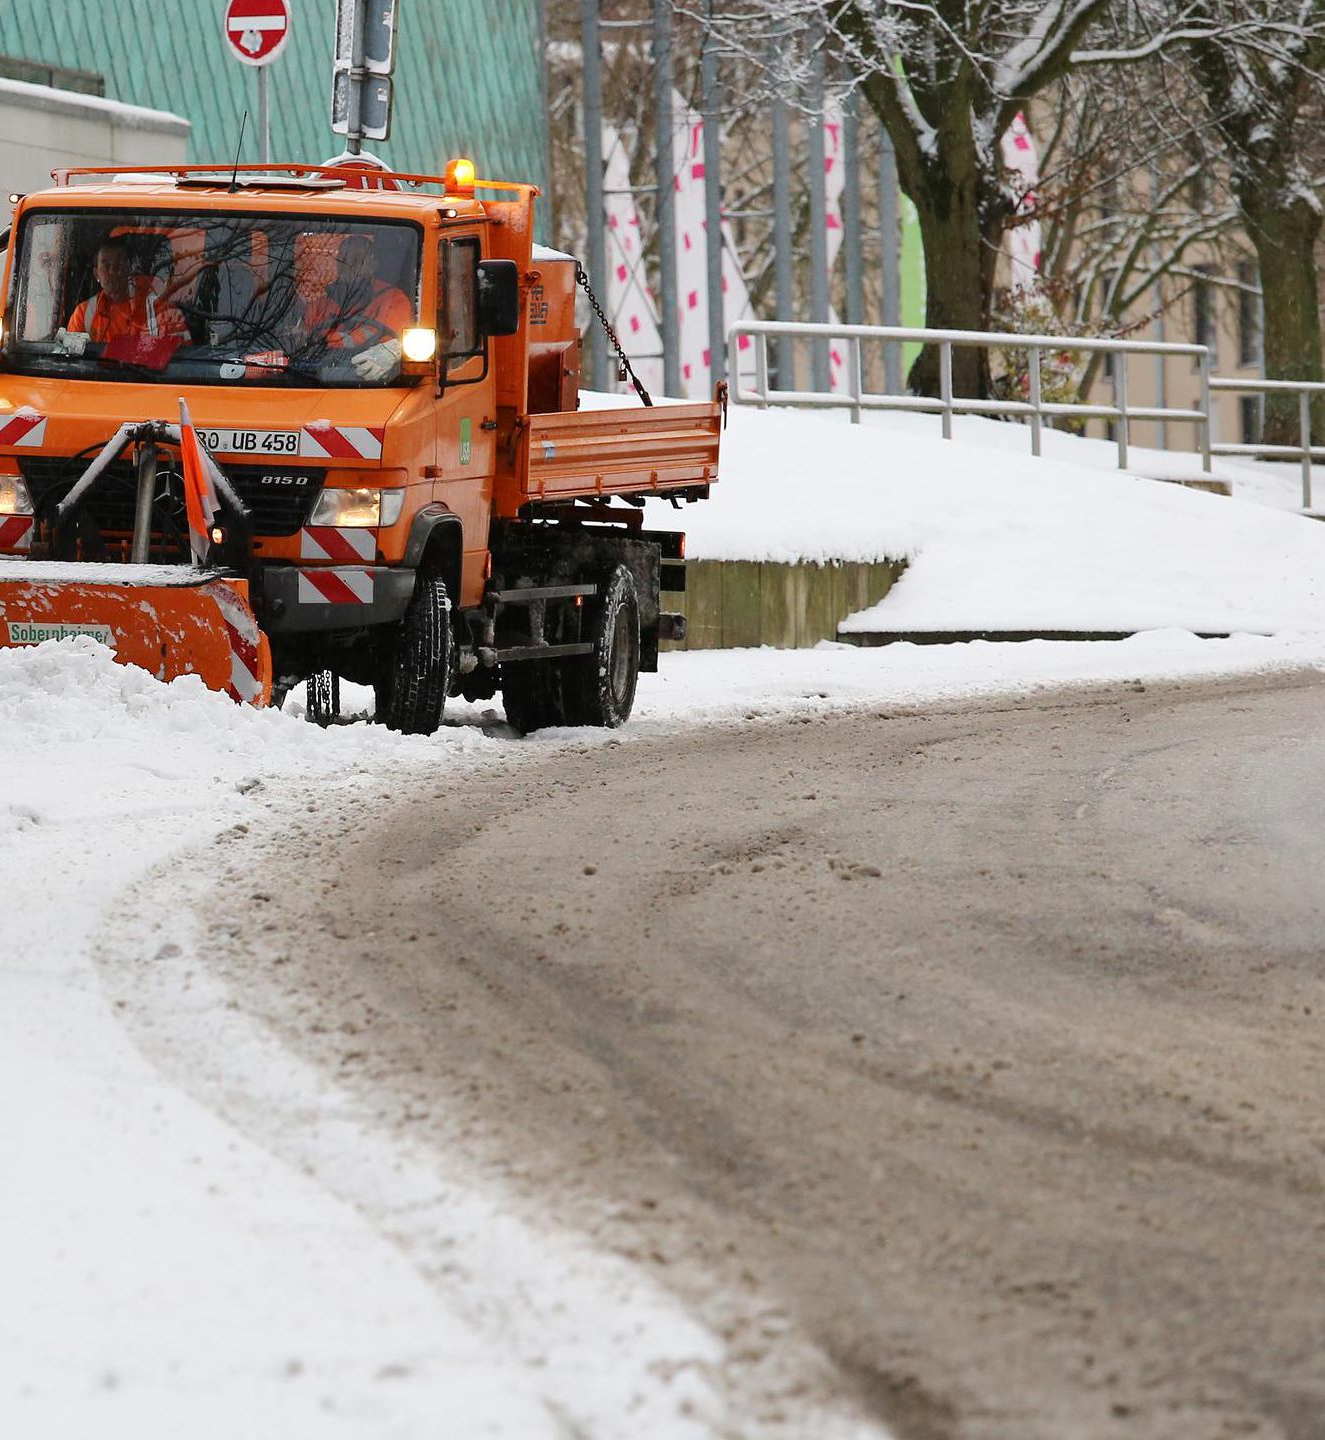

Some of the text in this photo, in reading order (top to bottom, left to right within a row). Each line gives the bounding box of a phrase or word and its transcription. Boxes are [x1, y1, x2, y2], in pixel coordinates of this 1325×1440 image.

[232, 432, 257, 450] UB
[261, 434, 297, 452] 458
[261, 476, 308, 485] 815 D
